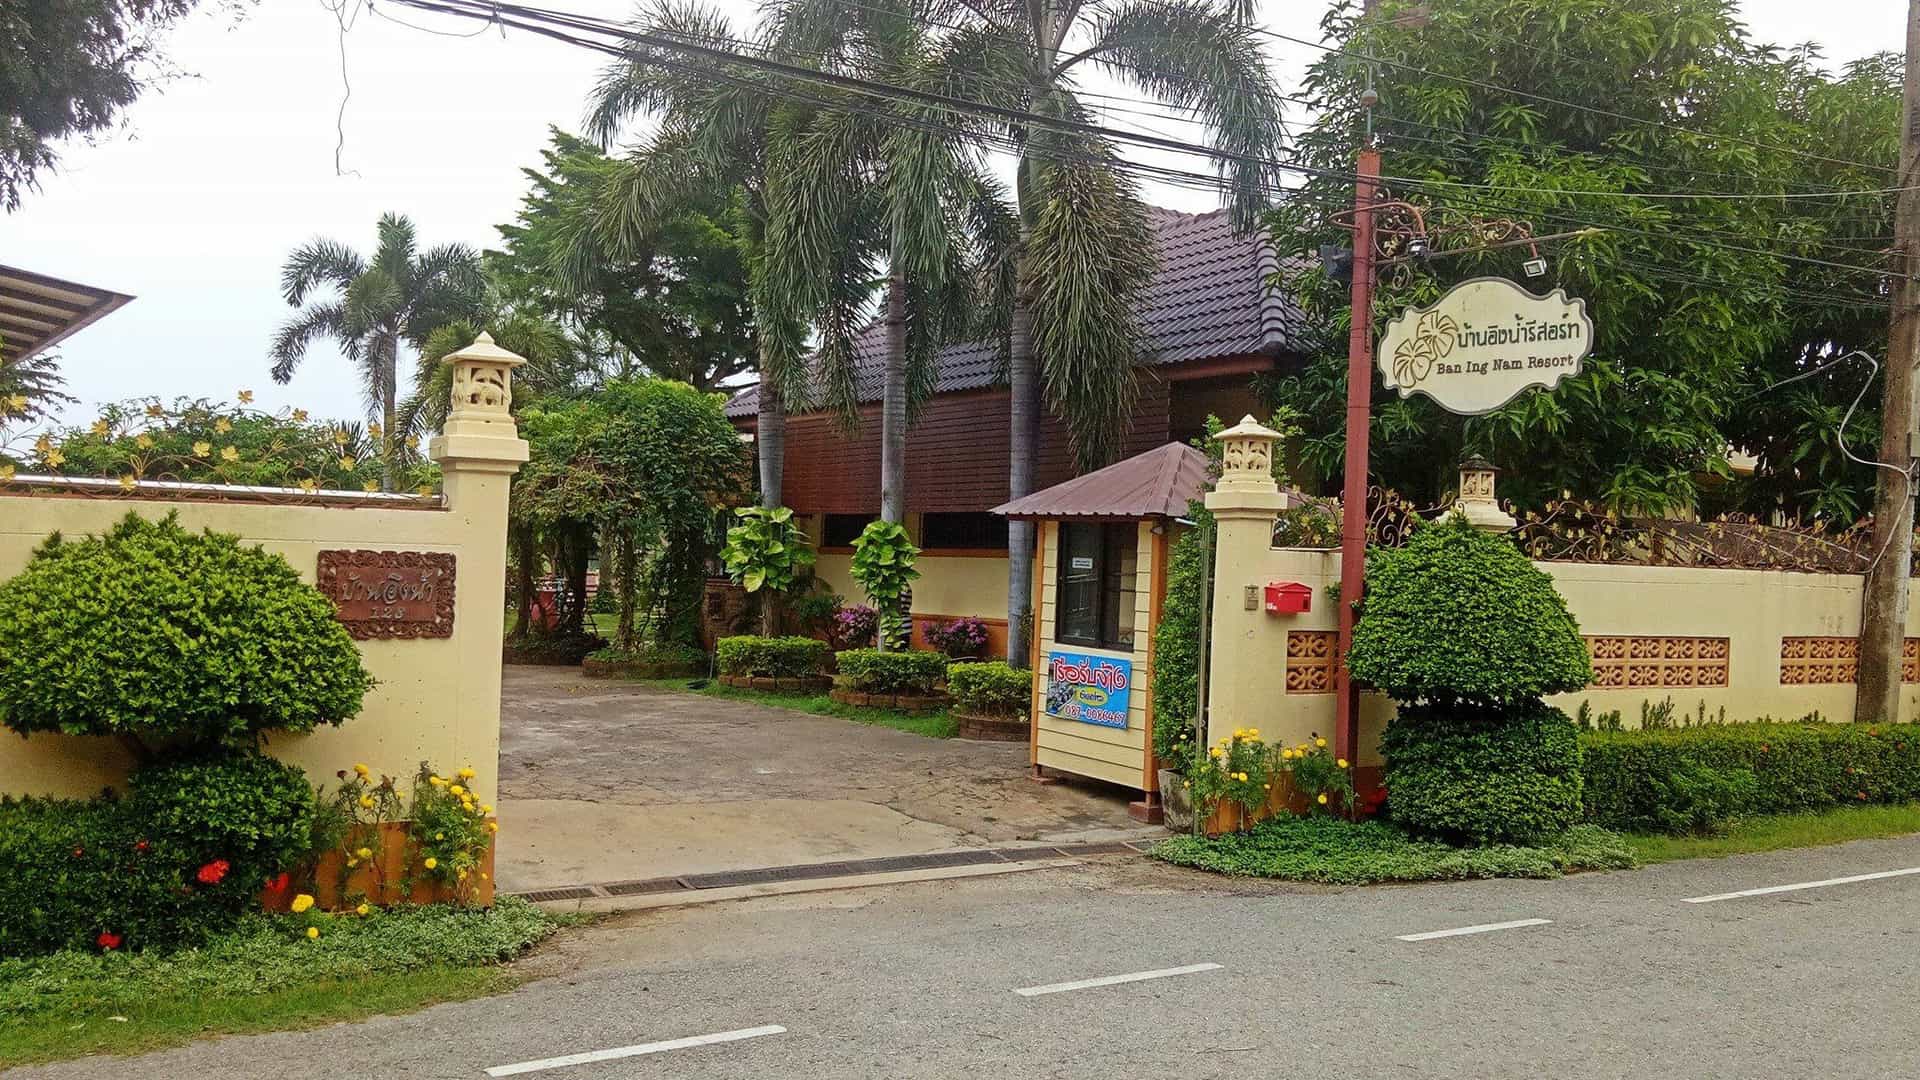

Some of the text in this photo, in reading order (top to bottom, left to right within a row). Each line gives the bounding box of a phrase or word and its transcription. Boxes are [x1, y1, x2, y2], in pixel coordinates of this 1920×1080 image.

[1457, 313, 1580, 349] บ้านอิงน้ำรีสอร์ท
[1436, 354, 1574, 375] Ban Ing Nam Resort
